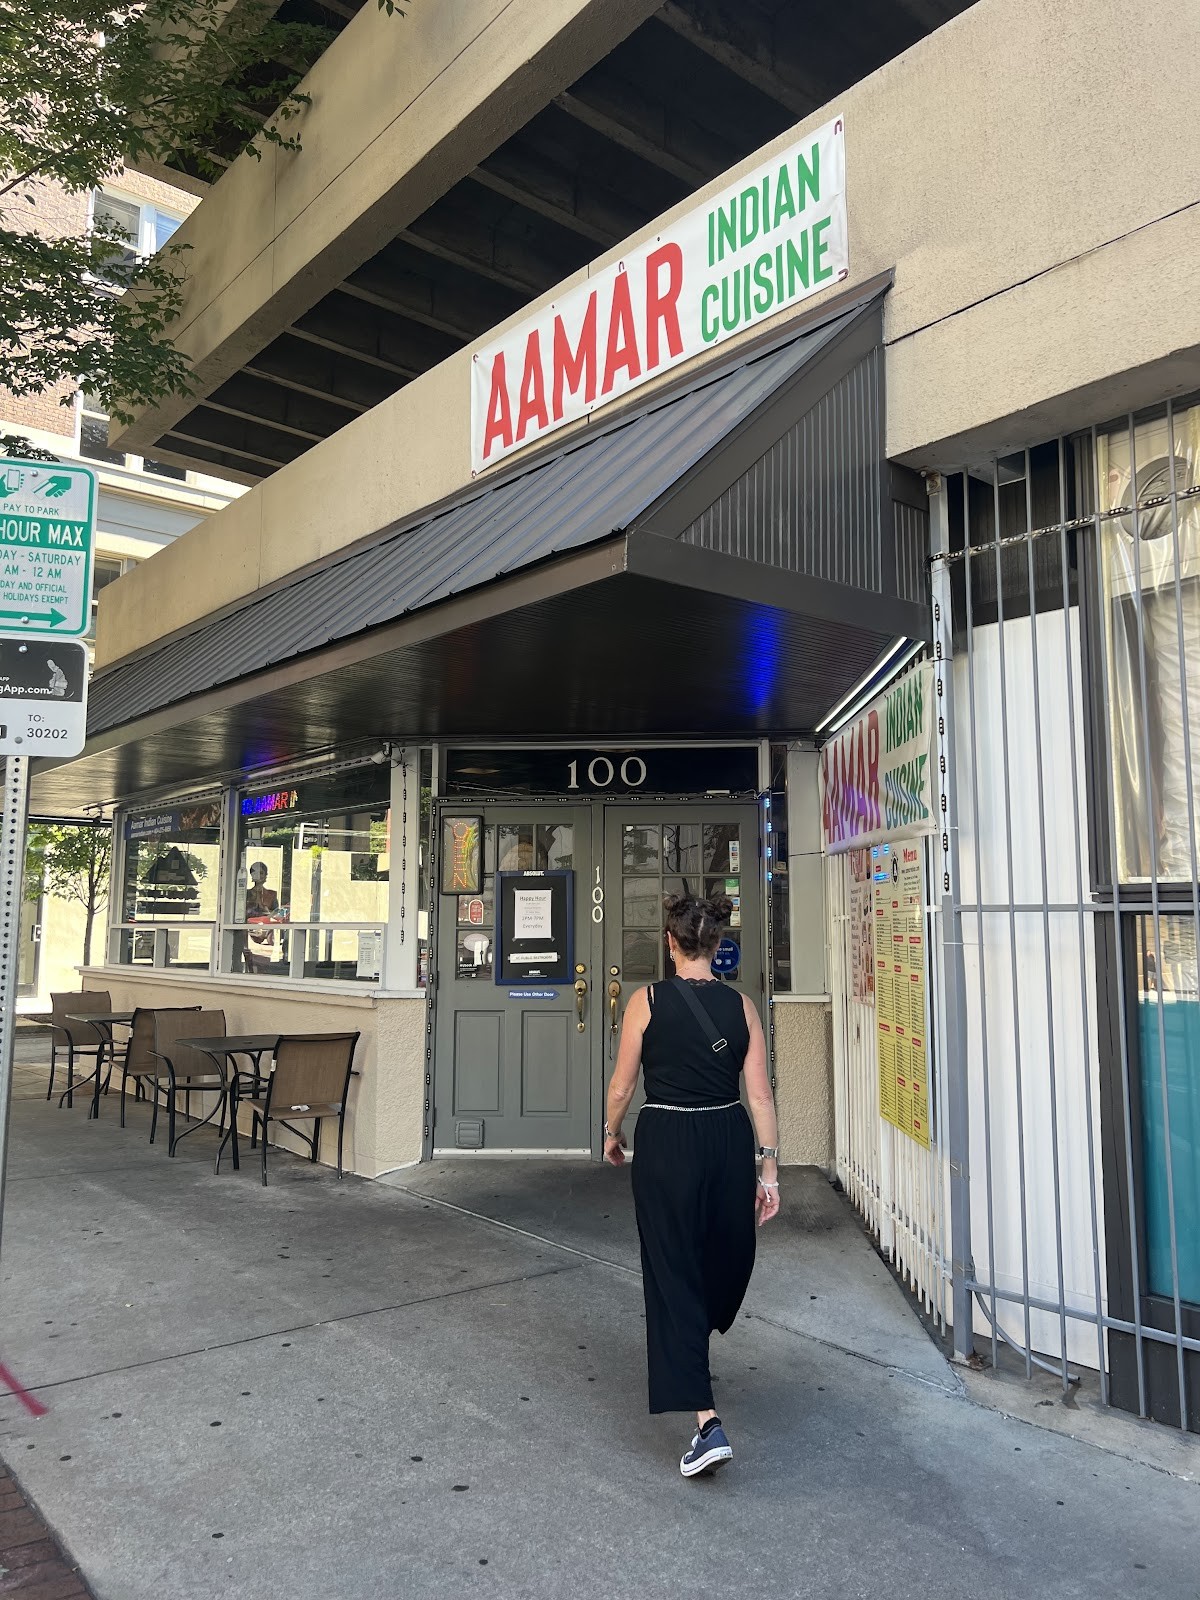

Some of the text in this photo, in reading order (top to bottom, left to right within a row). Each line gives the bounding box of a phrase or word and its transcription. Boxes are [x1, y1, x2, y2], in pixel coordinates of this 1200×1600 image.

[707, 141, 821, 268] INDIAN
[701, 216, 833, 343] CUISINE
[483, 242, 684, 461] AAMAR
[3, 503, 60, 516] PAY TO PARK
[48, 523, 84, 547] MAX
[28, 552, 81, 566] SATURDAY
[4, 564, 19, 575] AM
[33, 566, 43, 578] 12
[47, 568, 62, 579] AM
[3, 592, 69, 605] HOLIDAYS EXEMPT
[18, 581, 33, 591] AND
[35, 583, 67, 593] OFFICIAL
[28, 714, 45, 723] TO:
[885, 669, 923, 754] INDIAN
[27, 727, 68, 739] 30202
[567, 756, 647, 789] 100
[822, 709, 881, 845] AAMAR
[884, 753, 929, 831] CUISINE
[902, 848, 918, 863] Menu
[592, 865, 604, 924] 100
